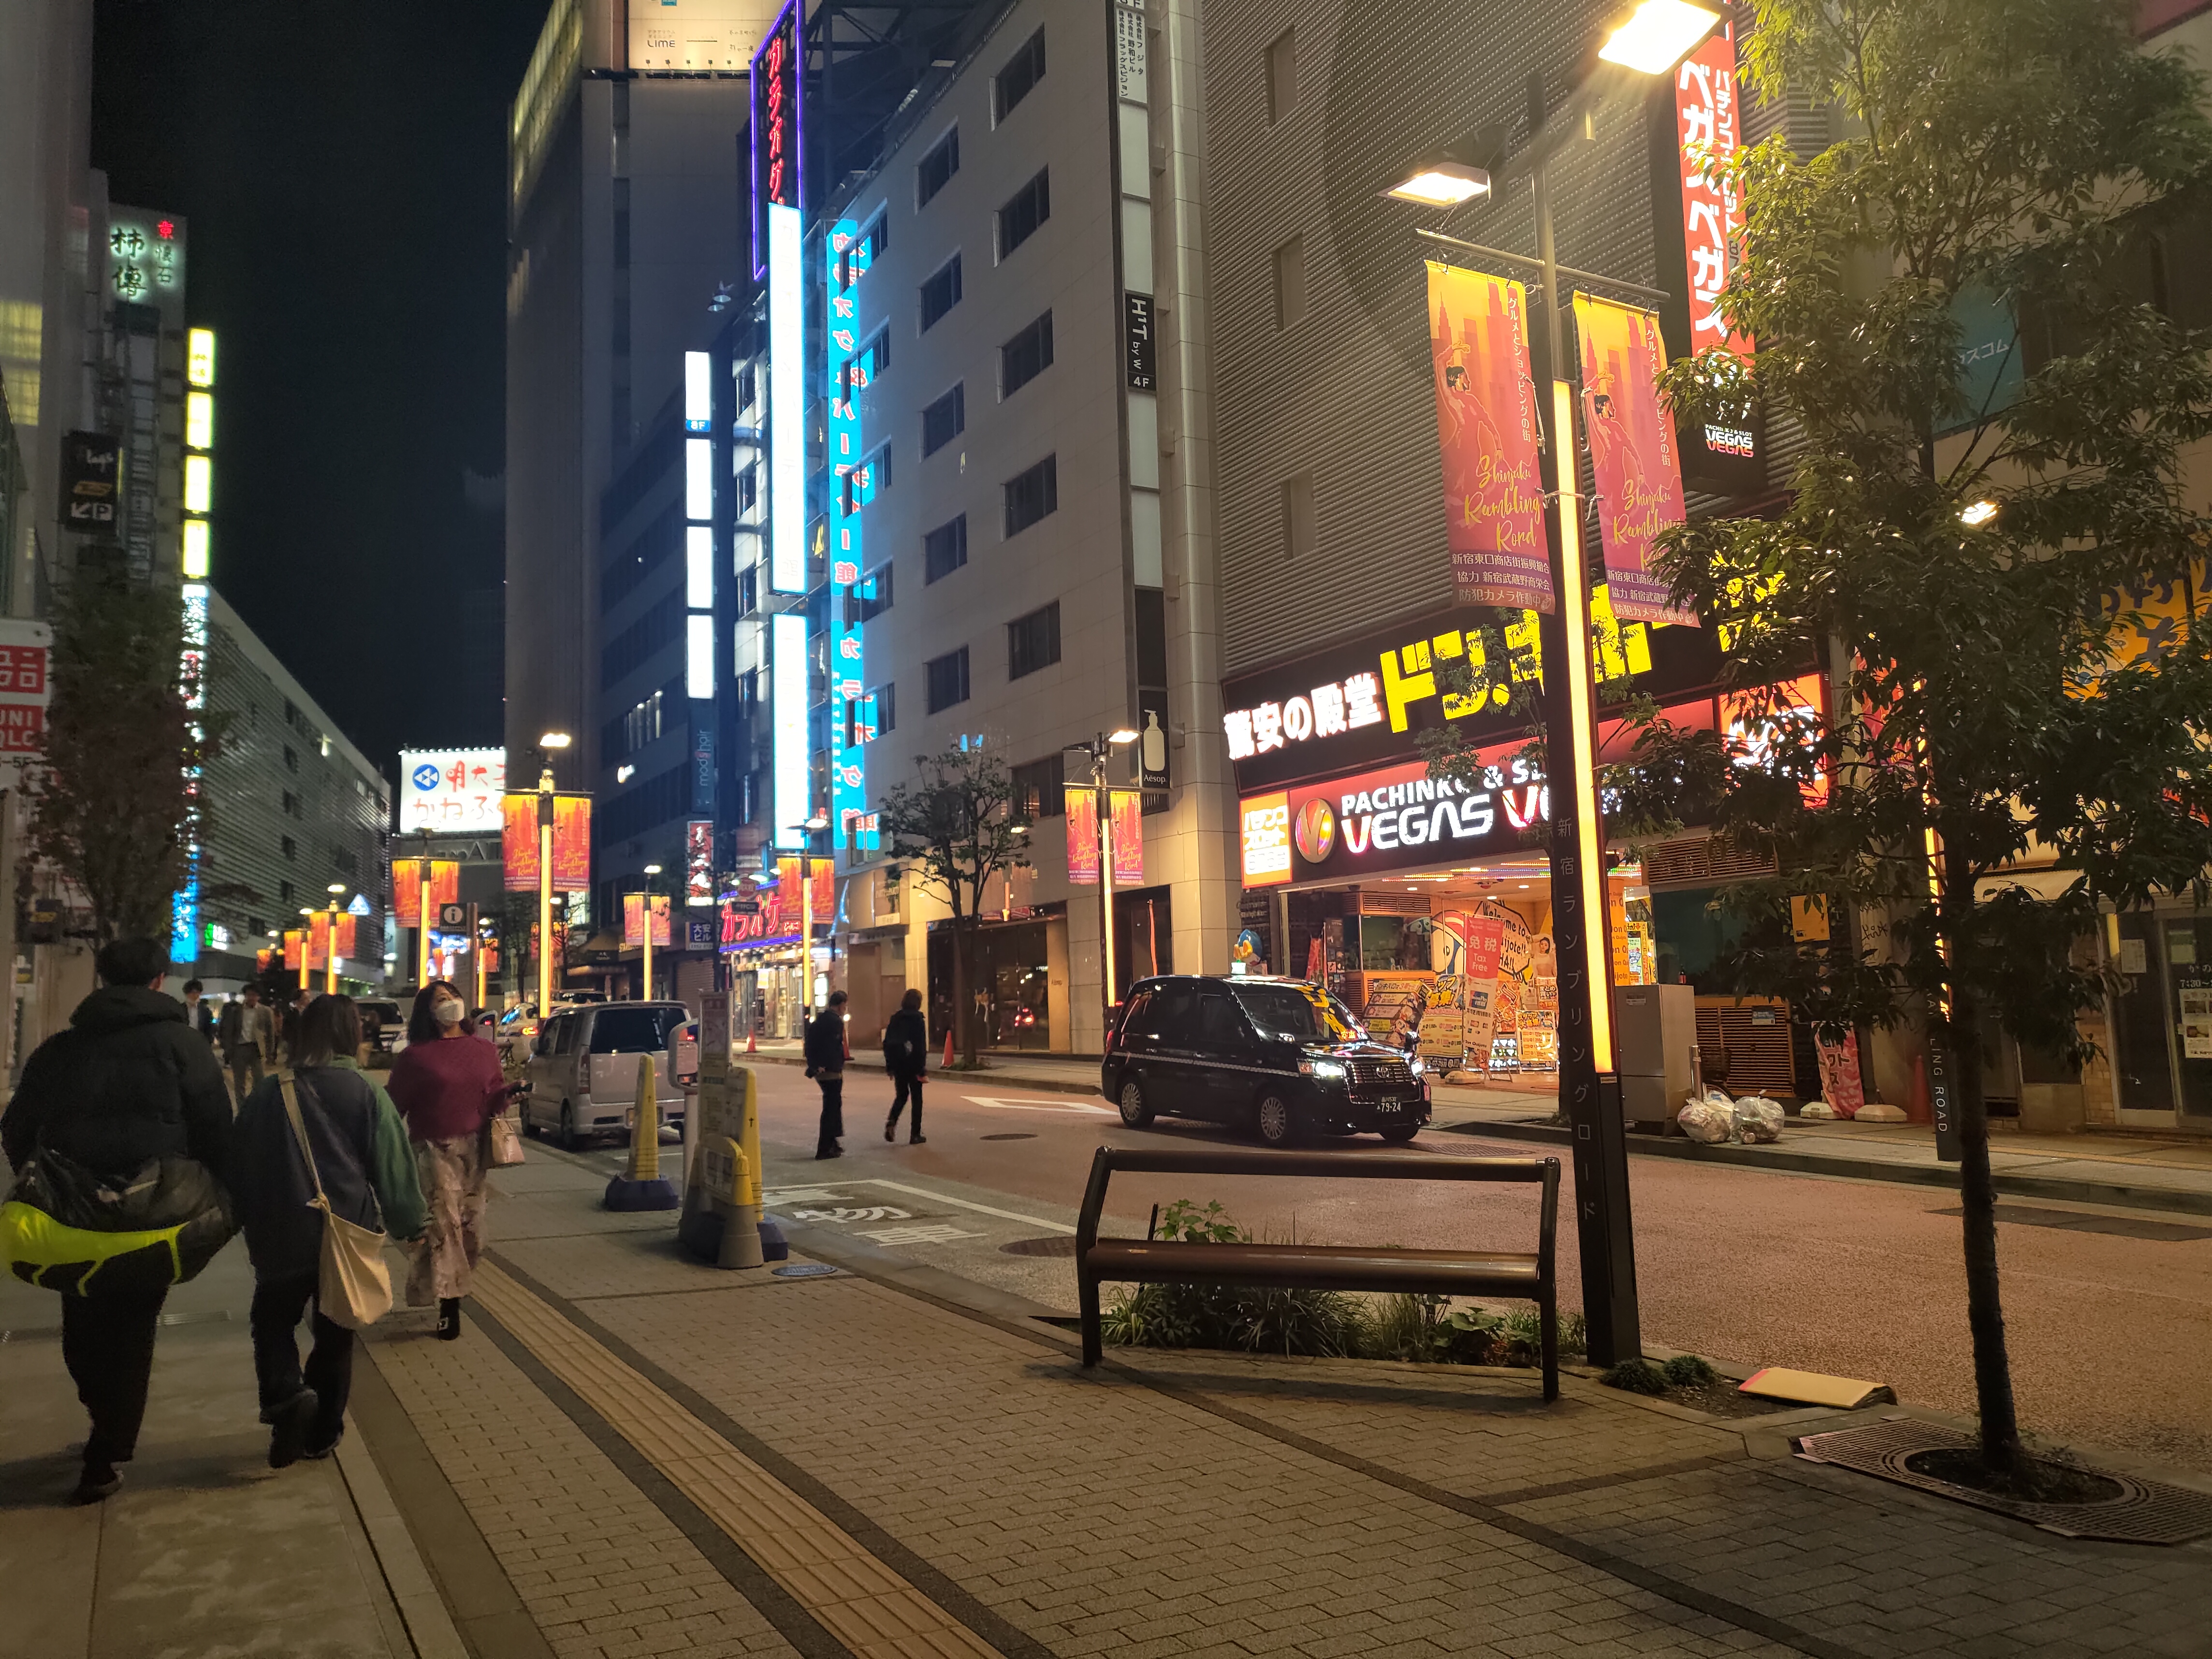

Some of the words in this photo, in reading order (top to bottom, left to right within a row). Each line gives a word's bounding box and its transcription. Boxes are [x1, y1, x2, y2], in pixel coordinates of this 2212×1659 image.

[1132, 341, 1141, 355] by
[1133, 359, 1142, 370] W
[1508, 296, 1532, 444] グルメとショッピングの街
[1134, 377, 1150, 388] 4F
[1705, 429, 1753, 449] VEGAS
[1706, 439, 1754, 458] VEGAS
[1464, 485, 1541, 526] Rambling
[1456, 571, 1479, 584] 協力
[1458, 588, 1542, 608] 防犯カメラ作動中
[1612, 587, 1628, 600] 協力
[1341, 793, 1495, 855] VEGAS
[1469, 935, 1497, 952] 免税
[1473, 953, 1487, 963] Tax
[1472, 962, 1488, 972] Free
[1557, 817, 1597, 1222] 新宿ランブリングロード
[1381, 1102, 1401, 1113] 79-24
[1935, 1085, 1948, 1133] ROAD
